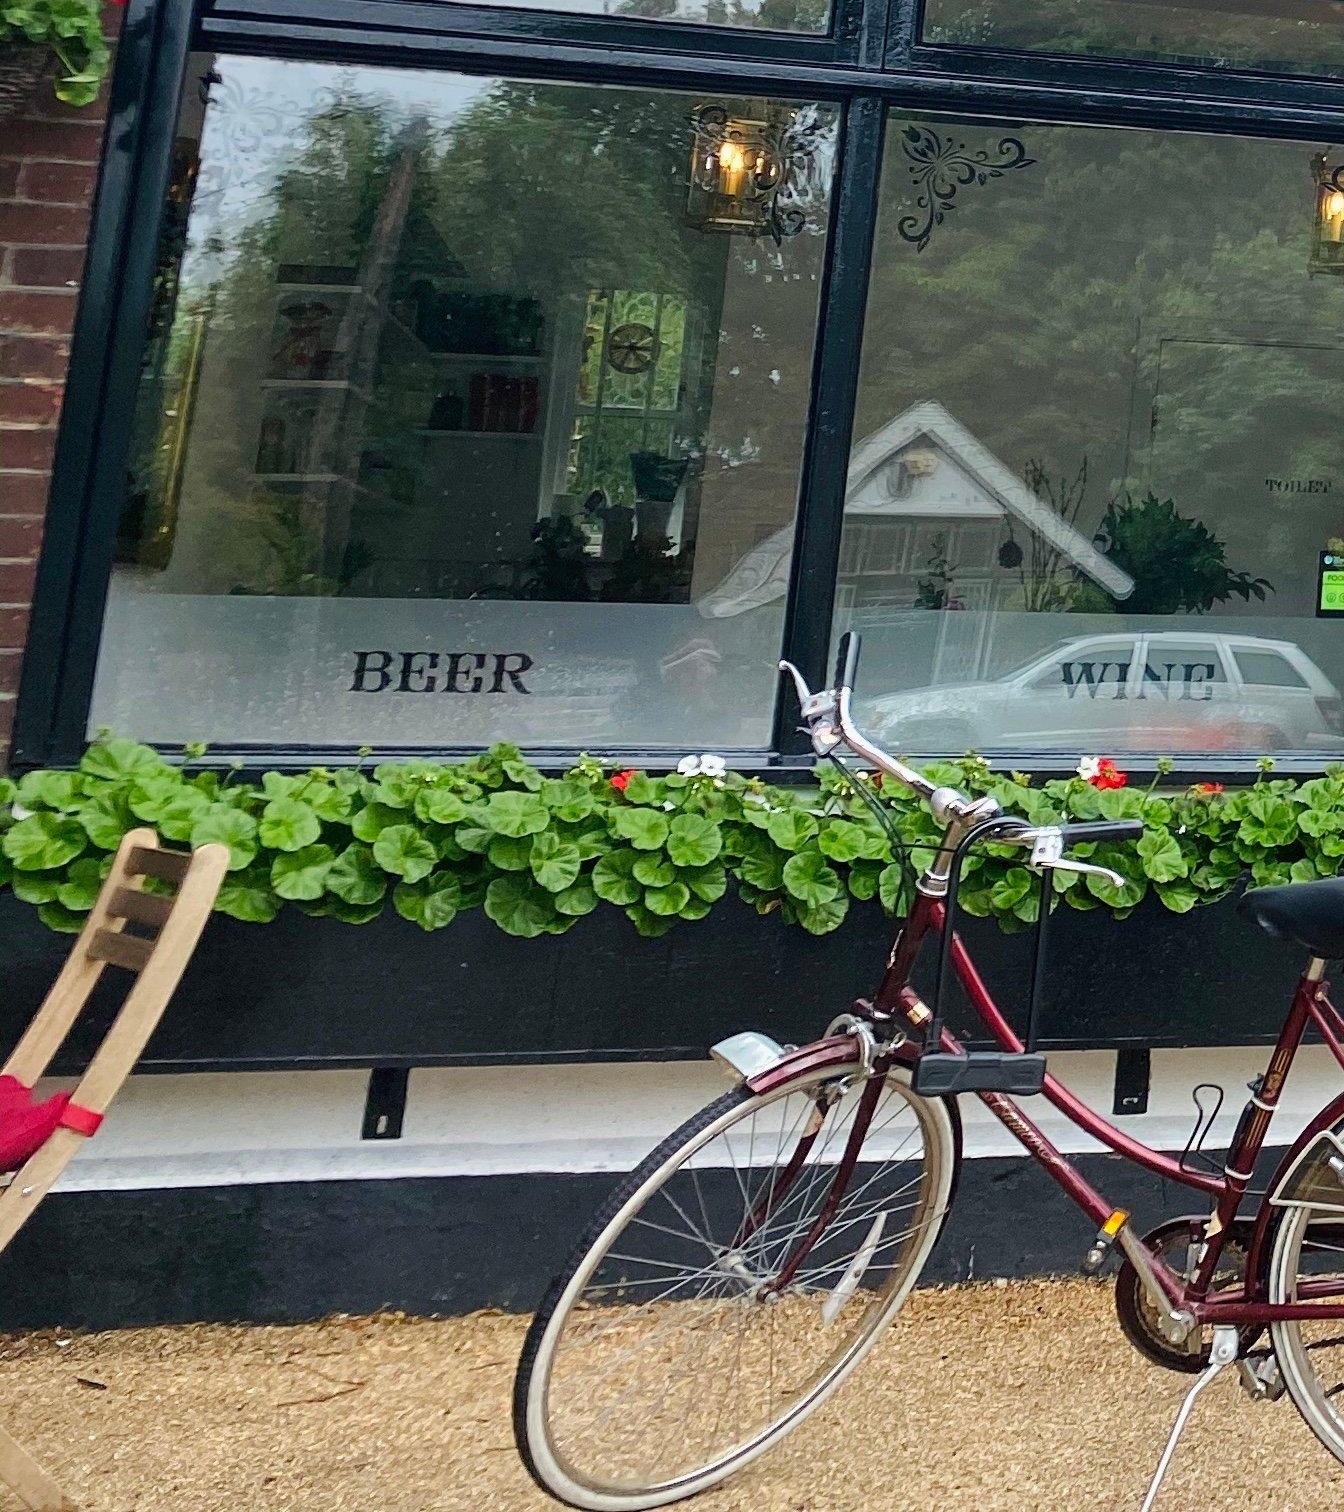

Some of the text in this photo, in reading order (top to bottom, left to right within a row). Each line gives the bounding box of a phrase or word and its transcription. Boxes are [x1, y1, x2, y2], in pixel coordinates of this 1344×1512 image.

[1265, 479, 1332, 493] TOILET
[349, 649, 534, 695] BEER
[1060, 660, 1216, 702] WINE
